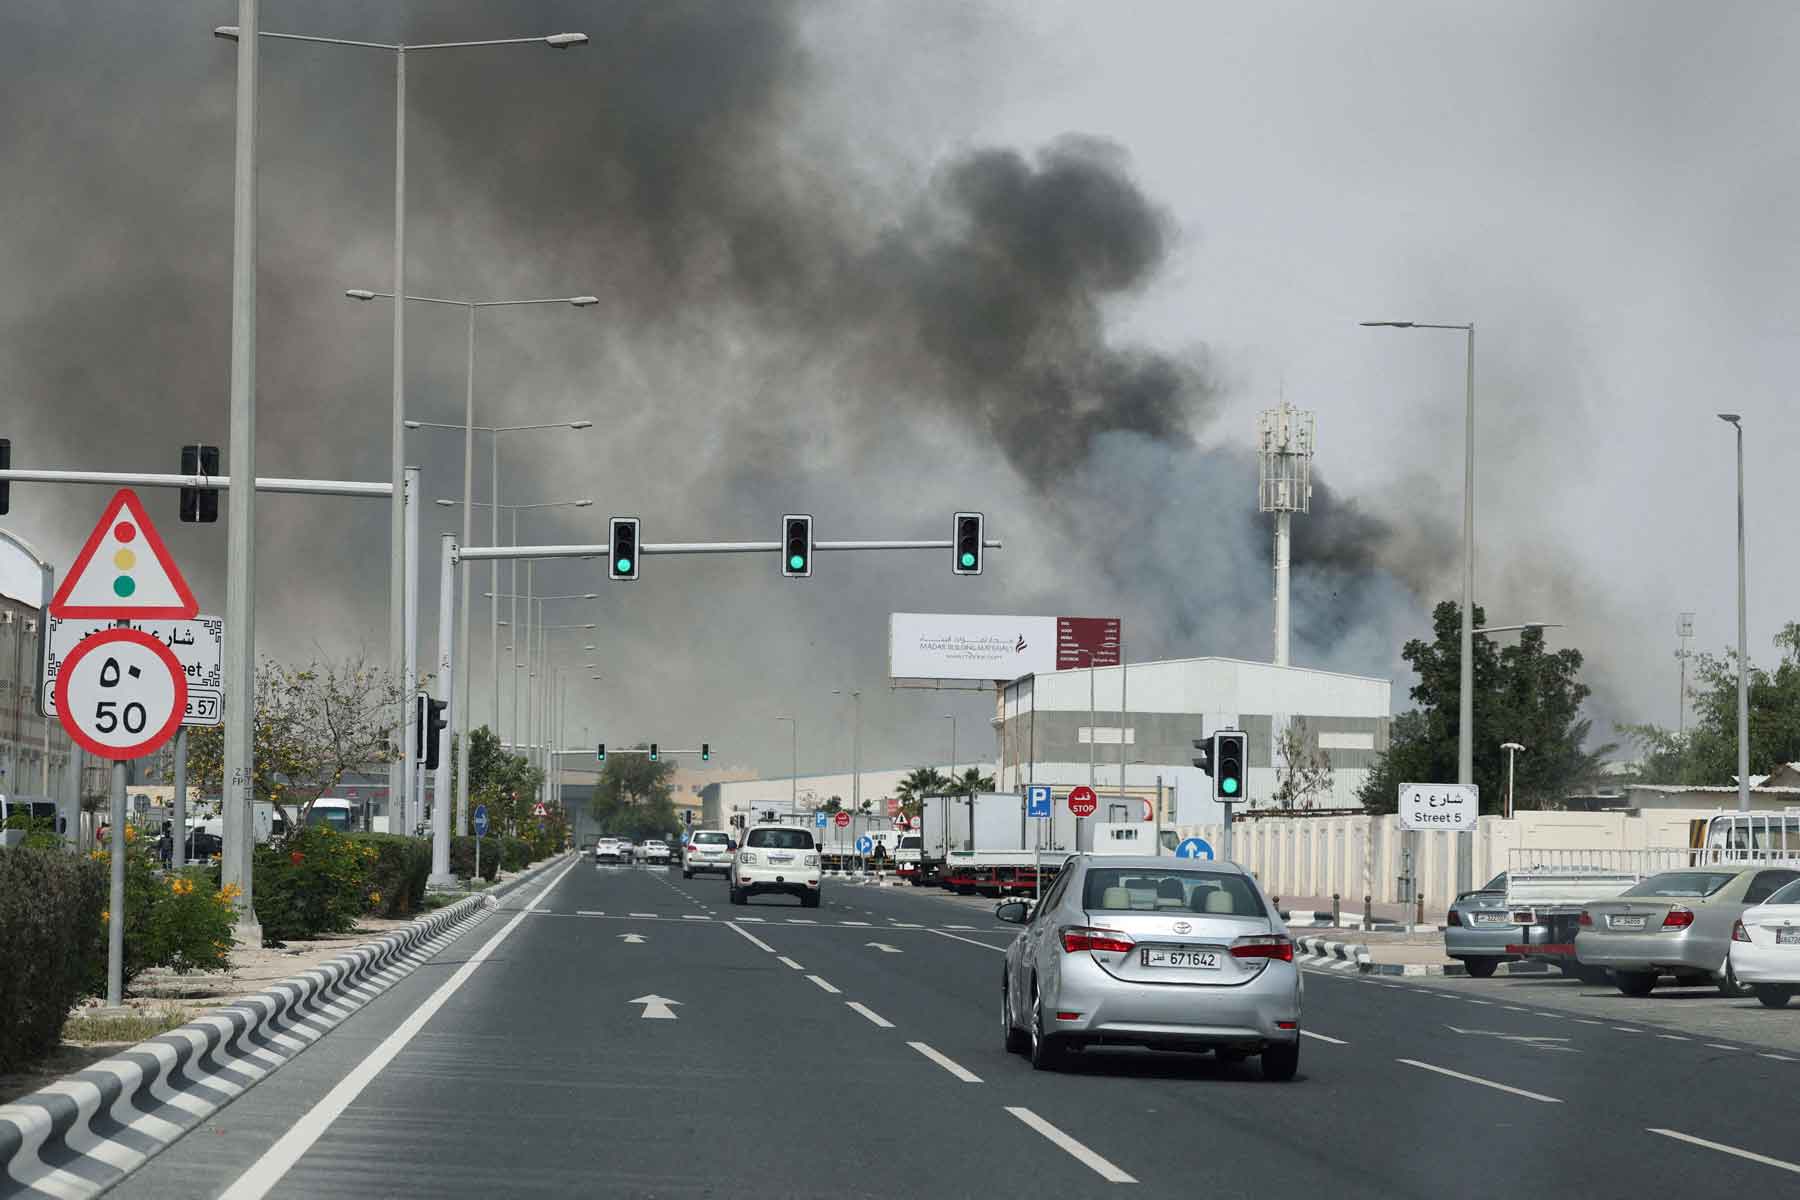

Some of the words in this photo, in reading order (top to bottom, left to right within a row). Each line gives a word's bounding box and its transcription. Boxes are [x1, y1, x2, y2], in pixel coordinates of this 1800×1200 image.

[99, 656, 142, 688] ٥٠
[197, 700, 216, 716] 57
[95, 701, 147, 734] 50
[1031, 788, 1047, 808] P
[1429, 792, 1464, 808] شارع
[1072, 805, 1095, 813] STOP
[1414, 812, 1451, 823] Street
[1454, 812, 1462, 823] 5
[1170, 952, 1216, 967] 671642
